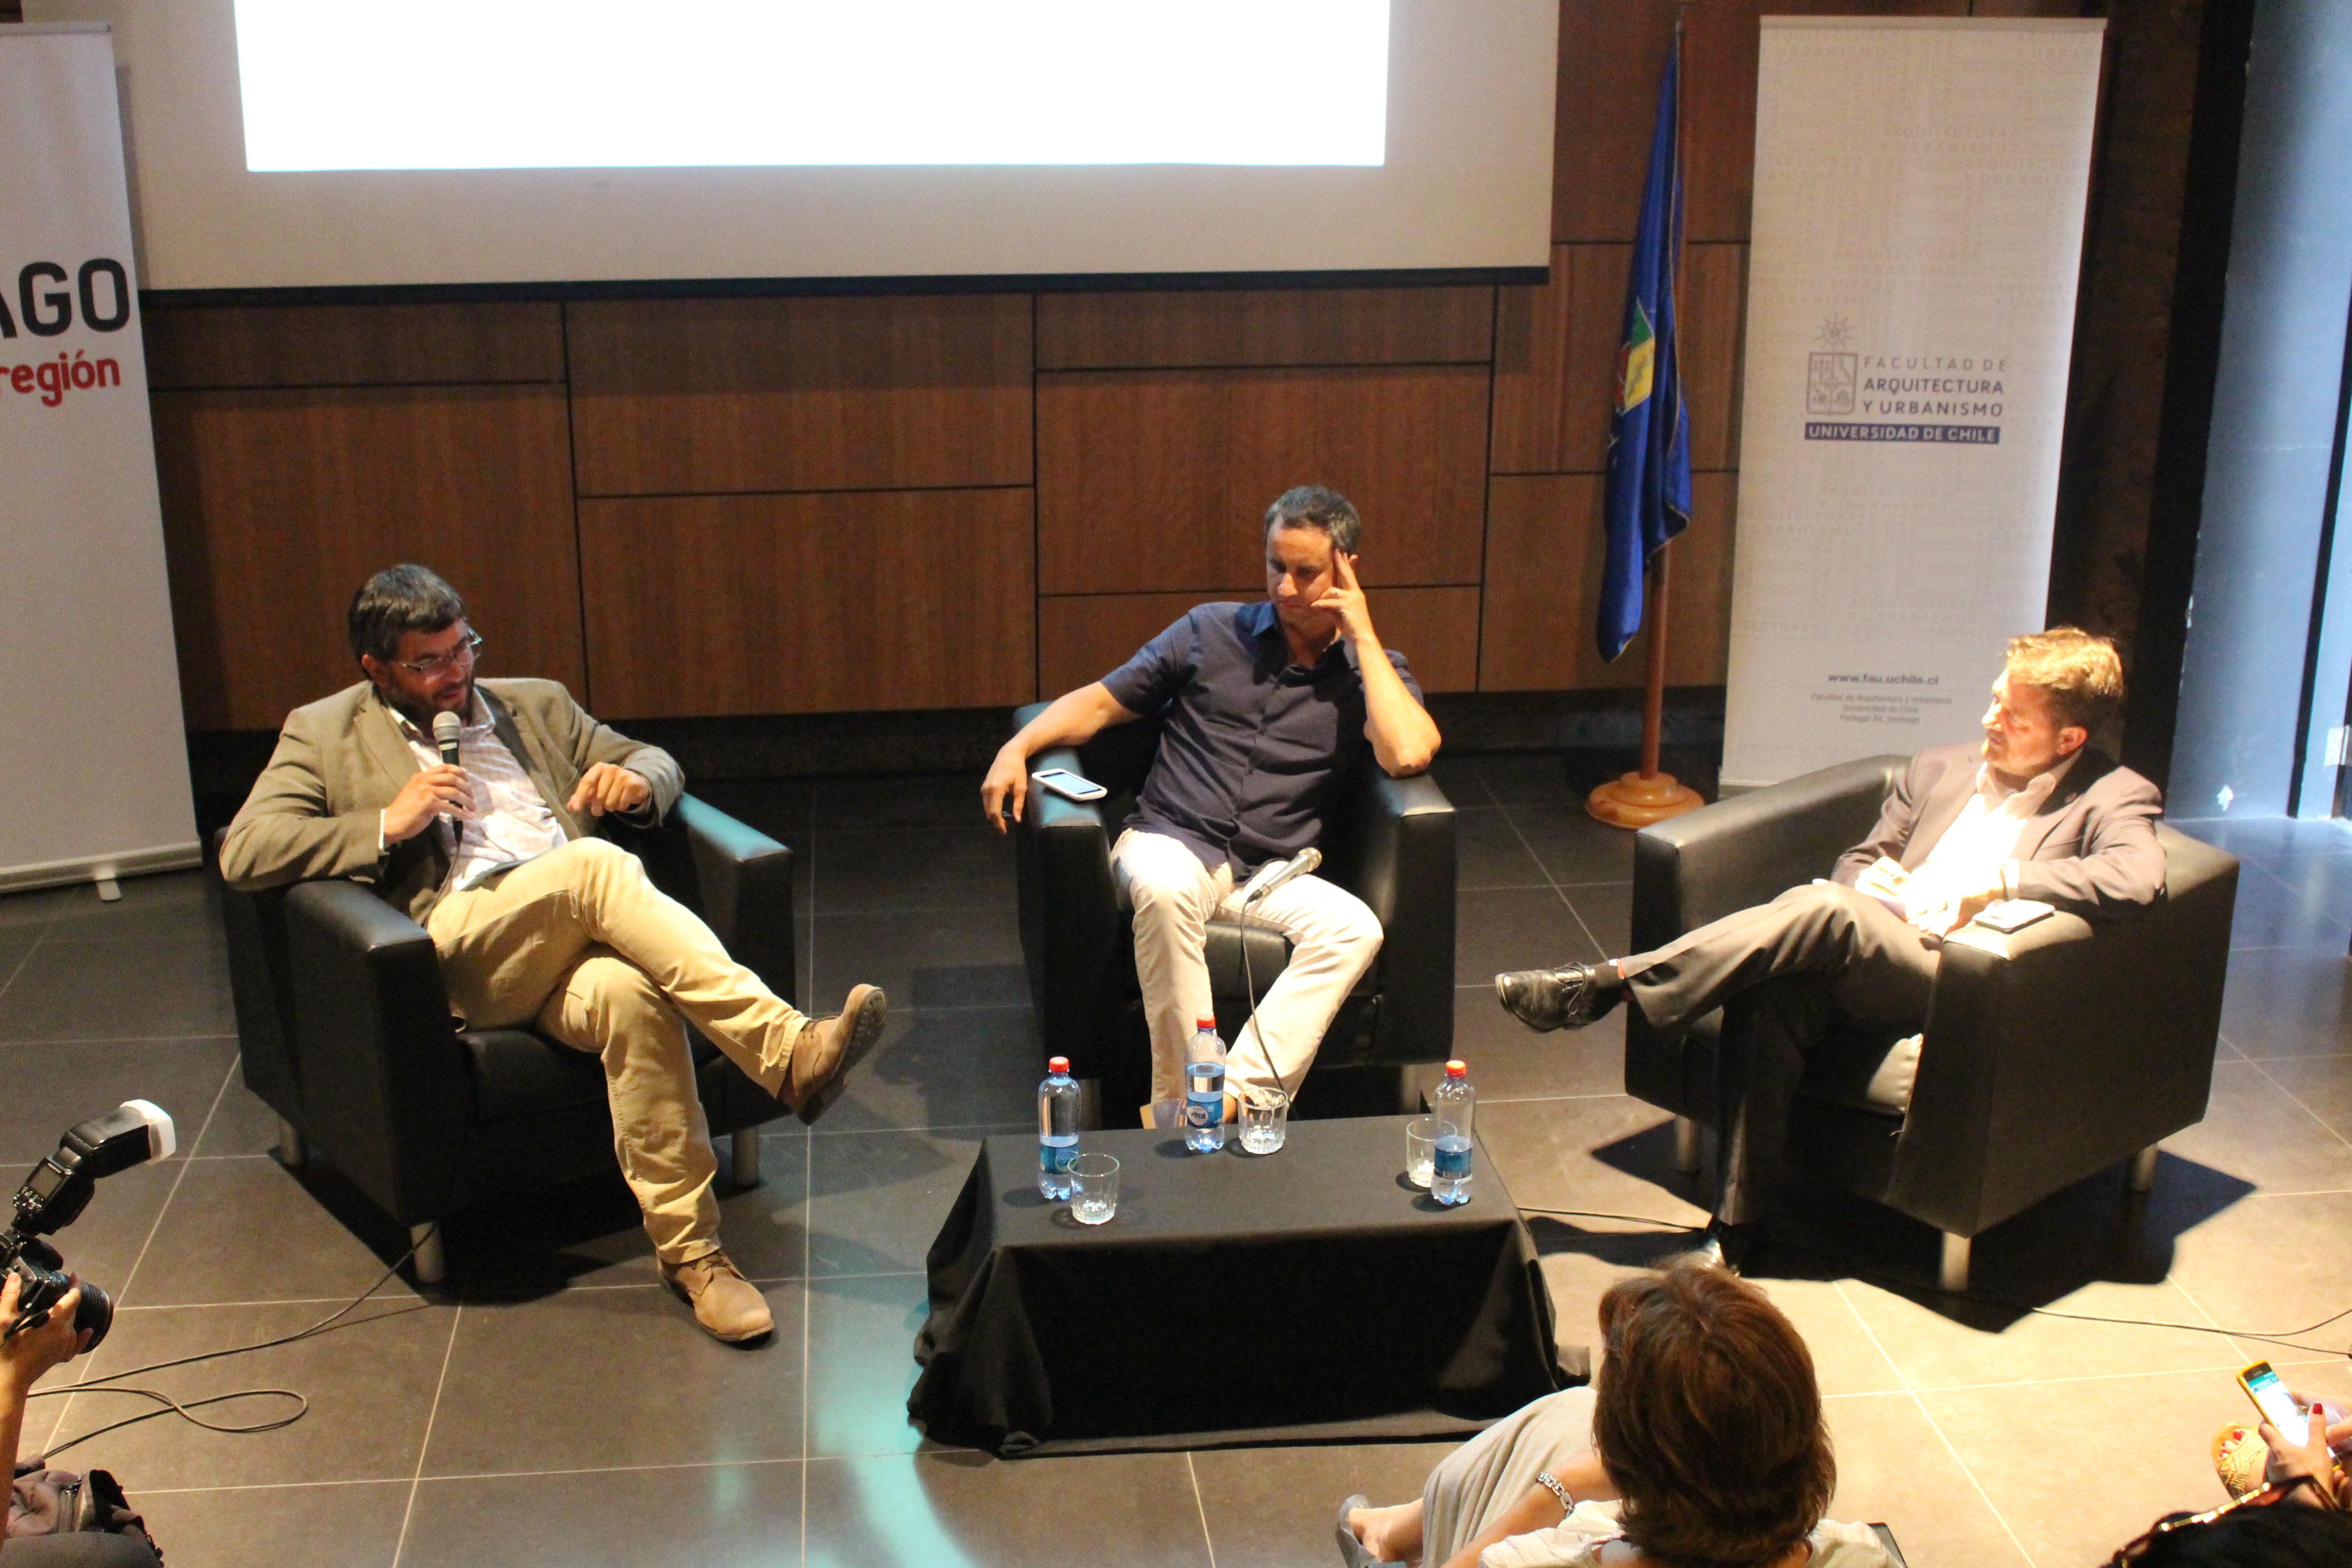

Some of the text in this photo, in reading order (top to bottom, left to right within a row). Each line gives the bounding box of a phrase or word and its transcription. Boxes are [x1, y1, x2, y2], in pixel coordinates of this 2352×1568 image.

[1863, 356, 2006, 372] FACULTAD DE
[1863, 378, 2004, 395] ARQUITECTURA
[1863, 401, 2003, 417] Y URBANISMO
[1808, 424, 1995, 443] UNIVERSIDAD DE CHILE
[1828, 673, 1939, 686] www.fau.uchile.cl
